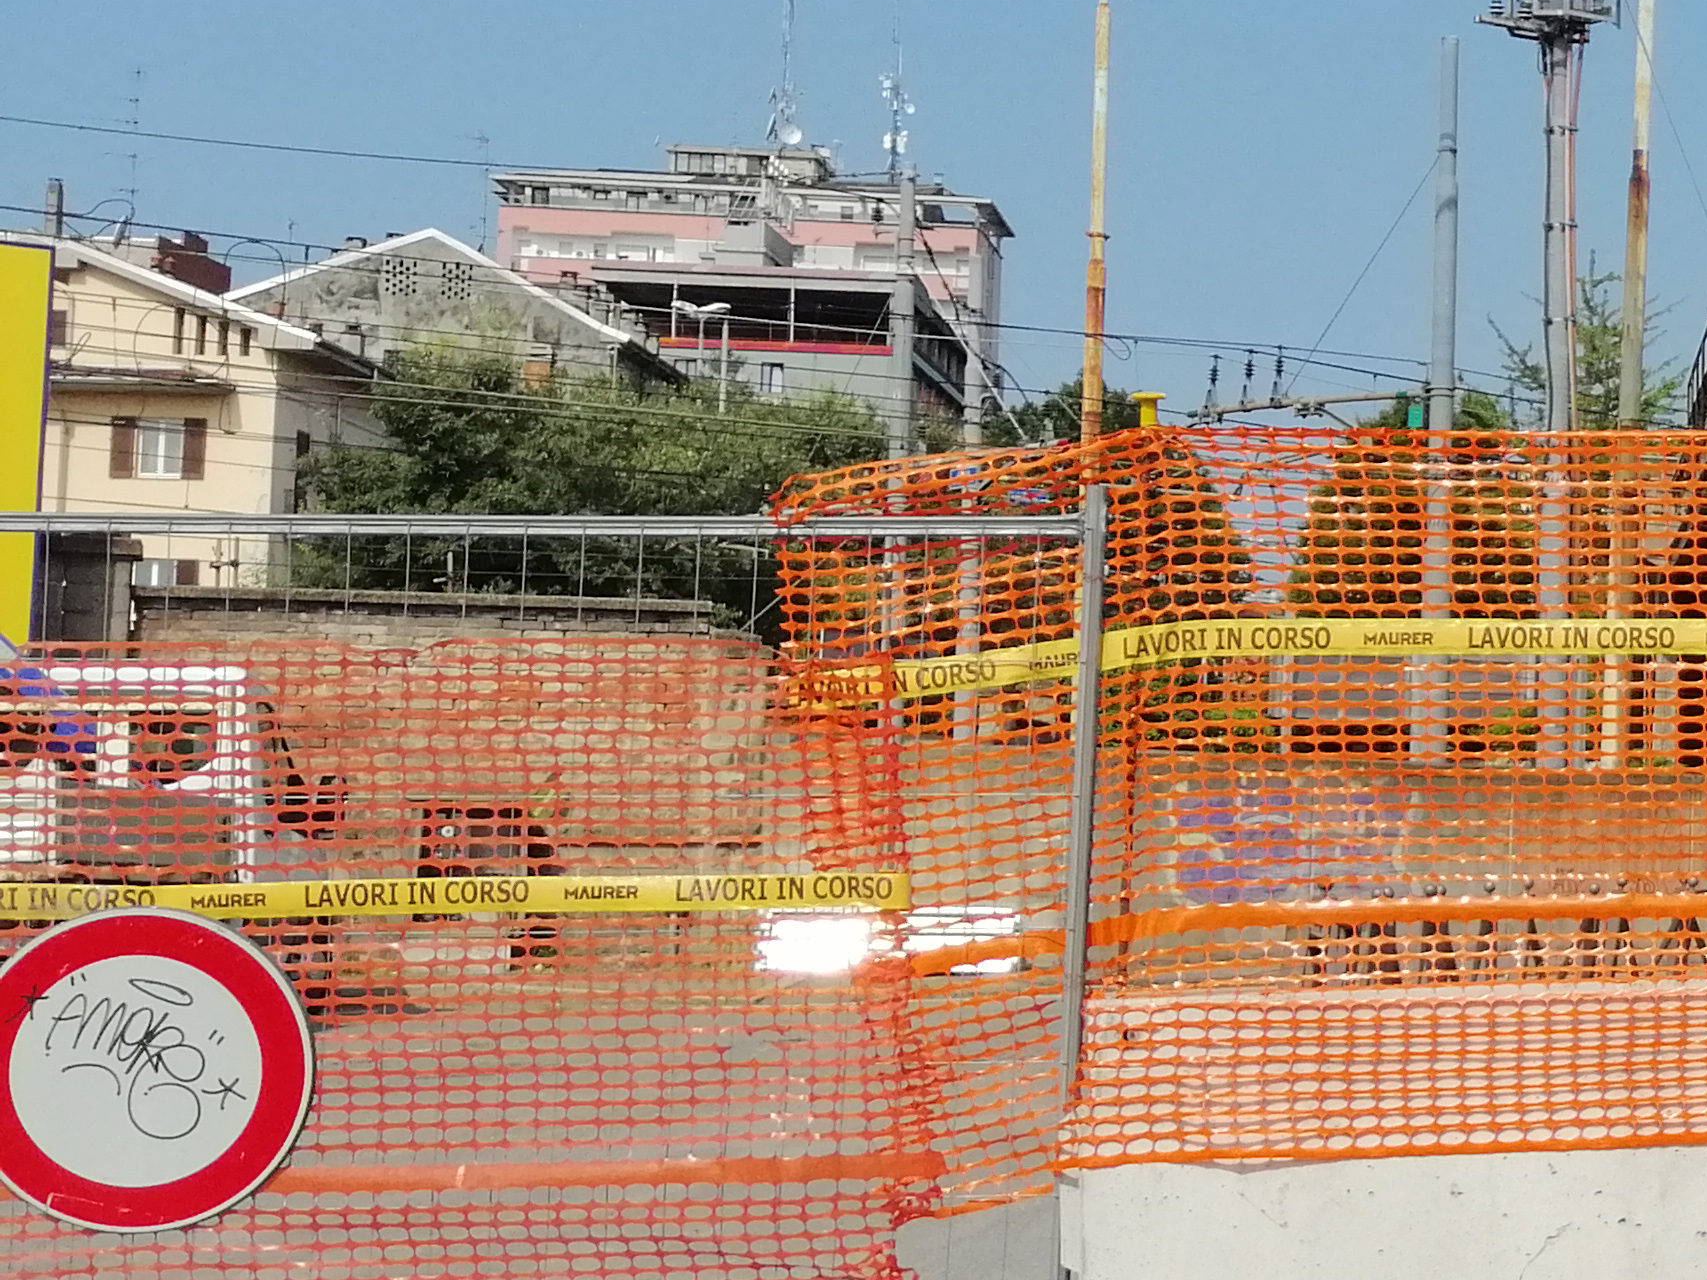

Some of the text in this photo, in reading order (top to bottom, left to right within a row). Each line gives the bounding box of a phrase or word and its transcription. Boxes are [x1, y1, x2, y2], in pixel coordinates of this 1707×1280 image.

[1123, 628, 1208, 659] LAVORI
[1216, 627, 1242, 650] IN
[1251, 626, 1331, 650] CORSO
[1363, 632, 1434, 646] MAURER
[1468, 626, 1554, 649] LAVORI
[1561, 626, 1588, 648] IN
[1596, 626, 1675, 649] CORSO
[915, 659, 997, 690] CORSO
[27, 887, 58, 910] IN
[67, 887, 156, 911] CORSO
[190, 893, 267, 909] MAURER
[304, 882, 398, 908] LAVORI
[407, 881, 436, 905] IN
[445, 879, 529, 904] CORSO
[564, 885, 639, 900] MAURER
[675, 878, 768, 902] LAVORI
[776, 876, 804, 900] IN
[813, 875, 893, 900] CORSO
